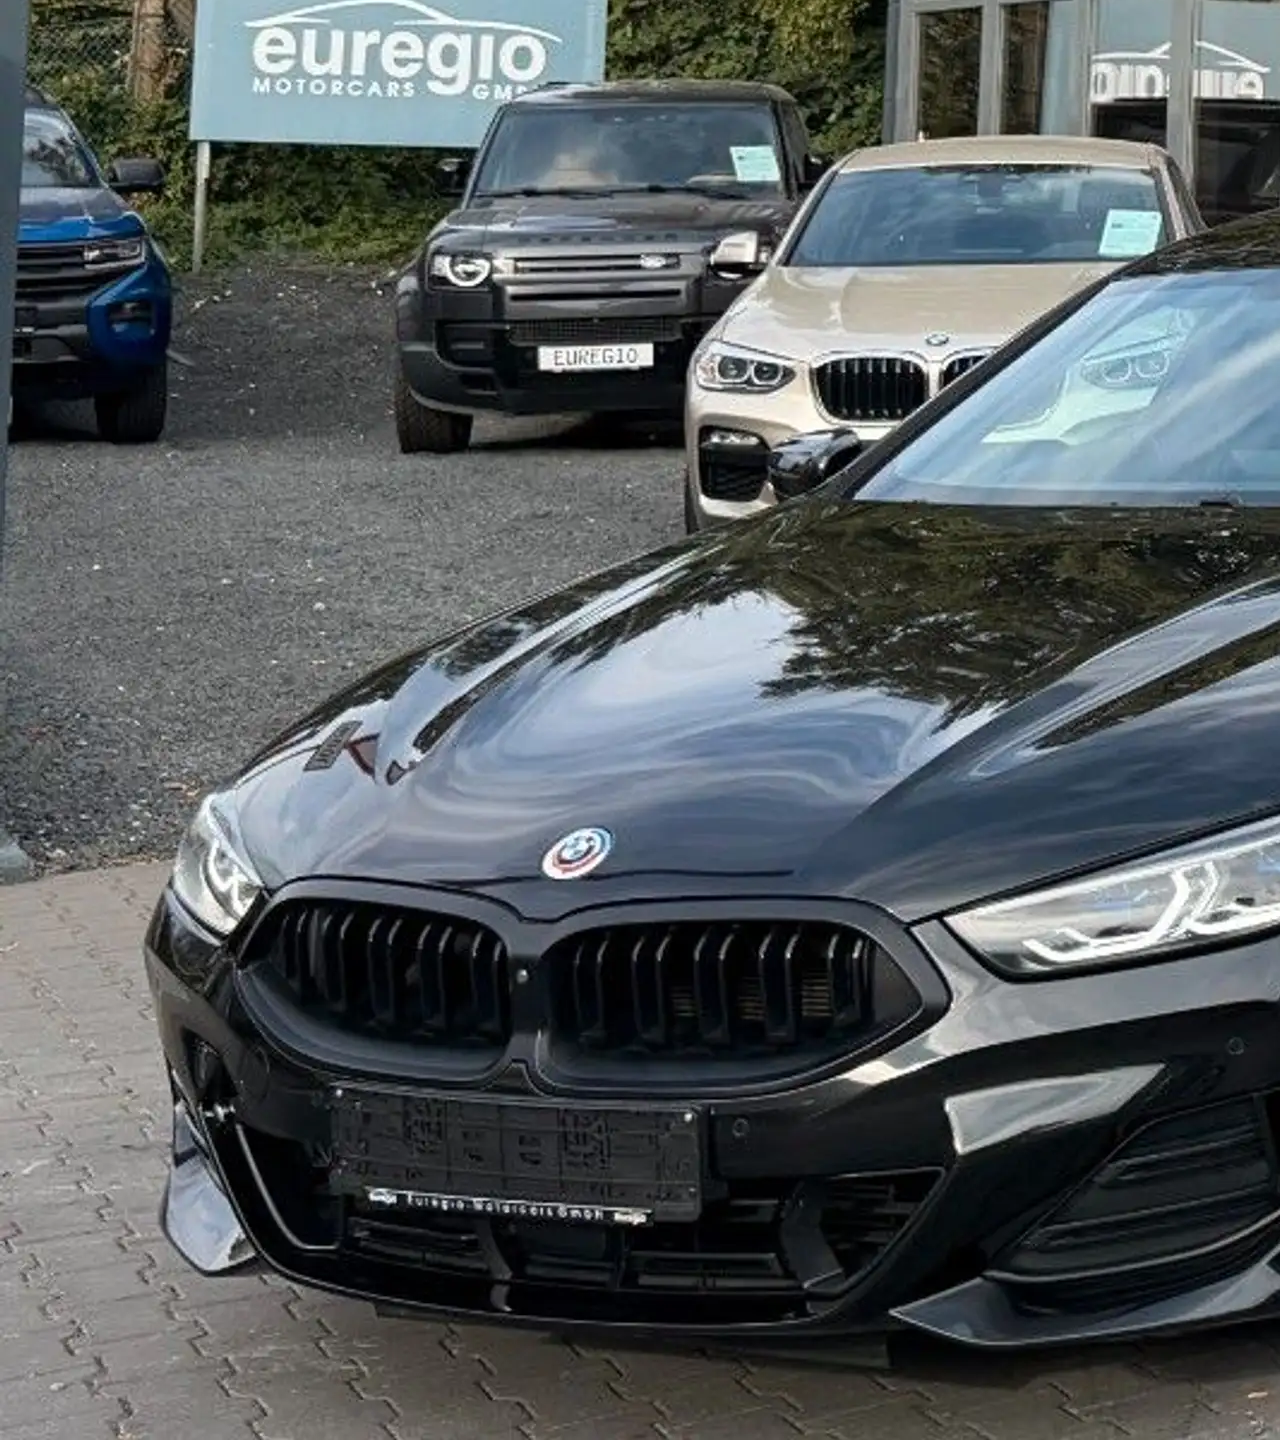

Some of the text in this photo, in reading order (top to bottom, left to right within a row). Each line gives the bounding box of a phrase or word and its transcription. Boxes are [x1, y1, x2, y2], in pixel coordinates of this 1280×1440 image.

[252, 25, 547, 96] euregio
[252, 76, 538, 101] MOTORCARS GM
